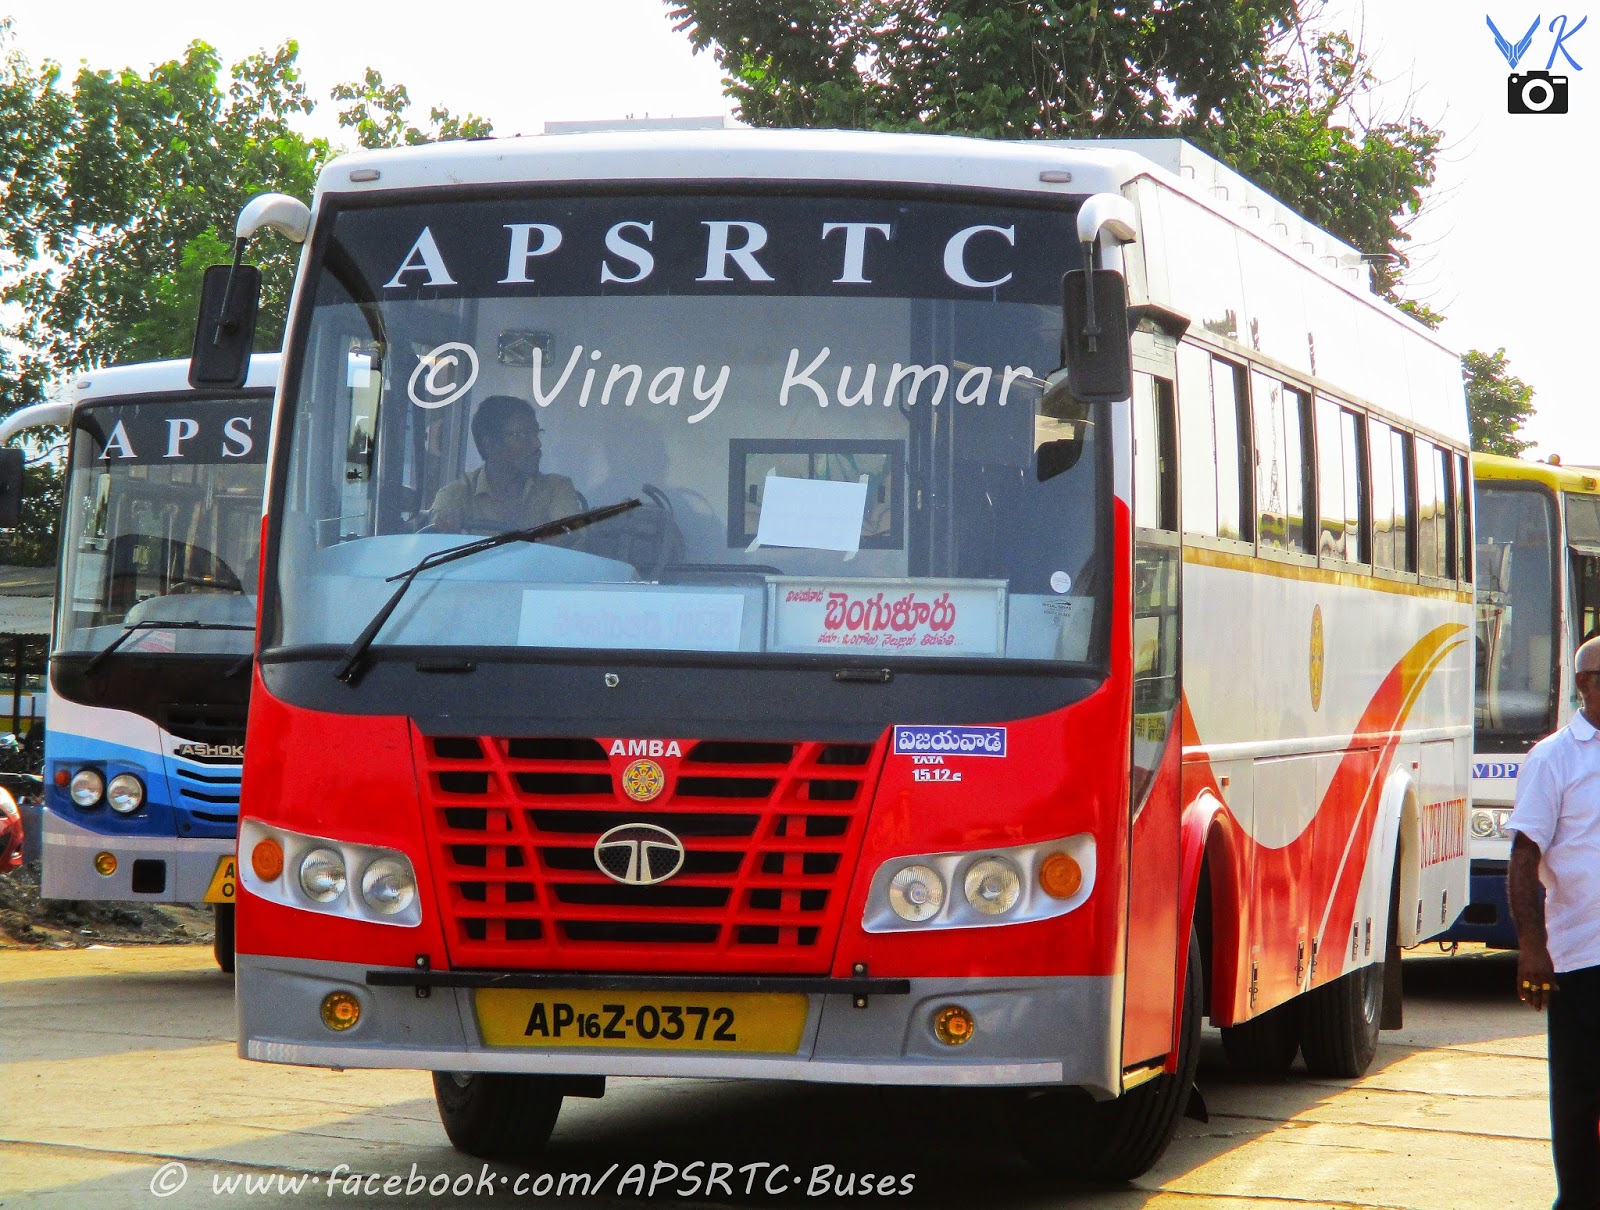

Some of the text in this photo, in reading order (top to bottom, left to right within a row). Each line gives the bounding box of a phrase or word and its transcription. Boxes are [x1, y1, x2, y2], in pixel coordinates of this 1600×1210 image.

[383, 220, 1017, 289] APSRTC
[100, 416, 254, 459] APS
[824, 592, 956, 632] బెంగుళూరు
[609, 739, 682, 757] AMBA
[898, 730, 1002, 752] విజయవాడ
[911, 755, 945, 765] TATA
[1472, 763, 1521, 778] VDP
